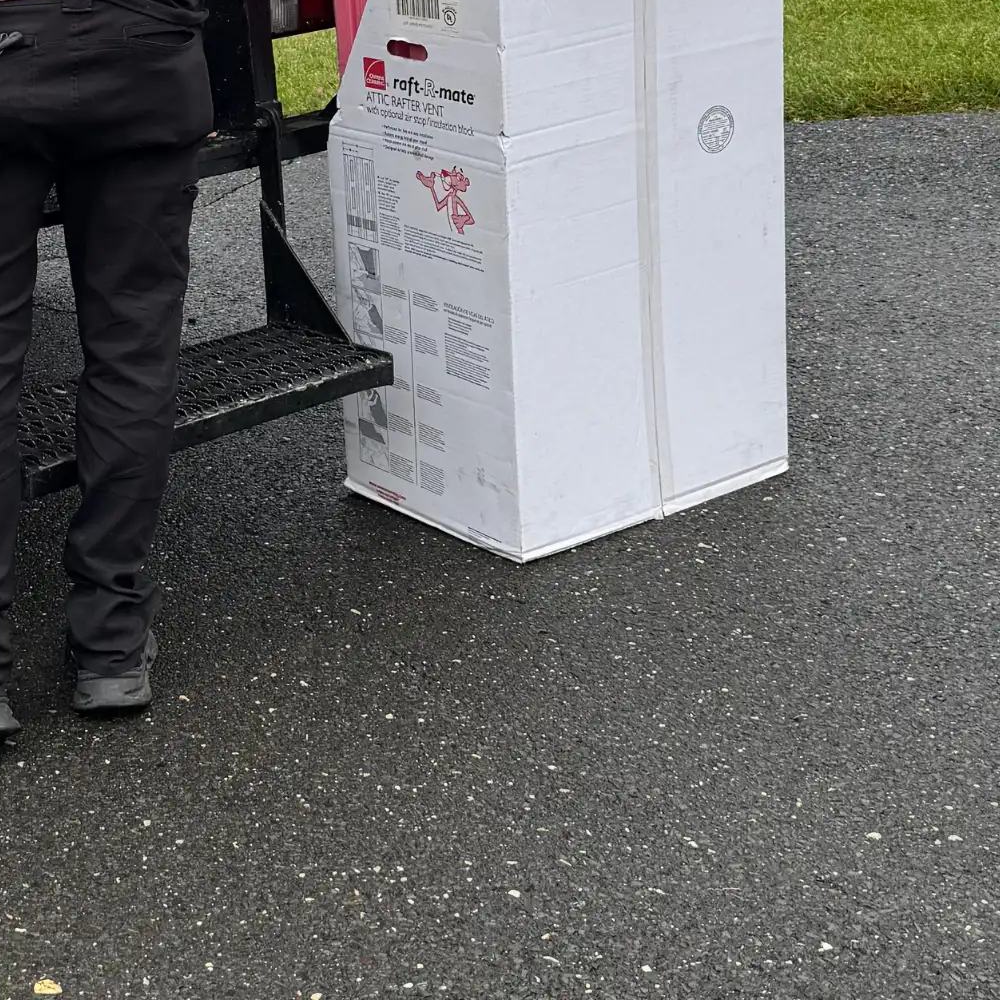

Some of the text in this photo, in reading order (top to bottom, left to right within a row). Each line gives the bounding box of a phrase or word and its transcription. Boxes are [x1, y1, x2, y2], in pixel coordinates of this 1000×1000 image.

[366, 91, 444, 117] ATTIC RAFTER VENT
[393, 77, 474, 105] raft-R-mate
[366, 105, 380, 115] with
[380, 109, 403, 121] optional
[458, 124, 475, 136] block
